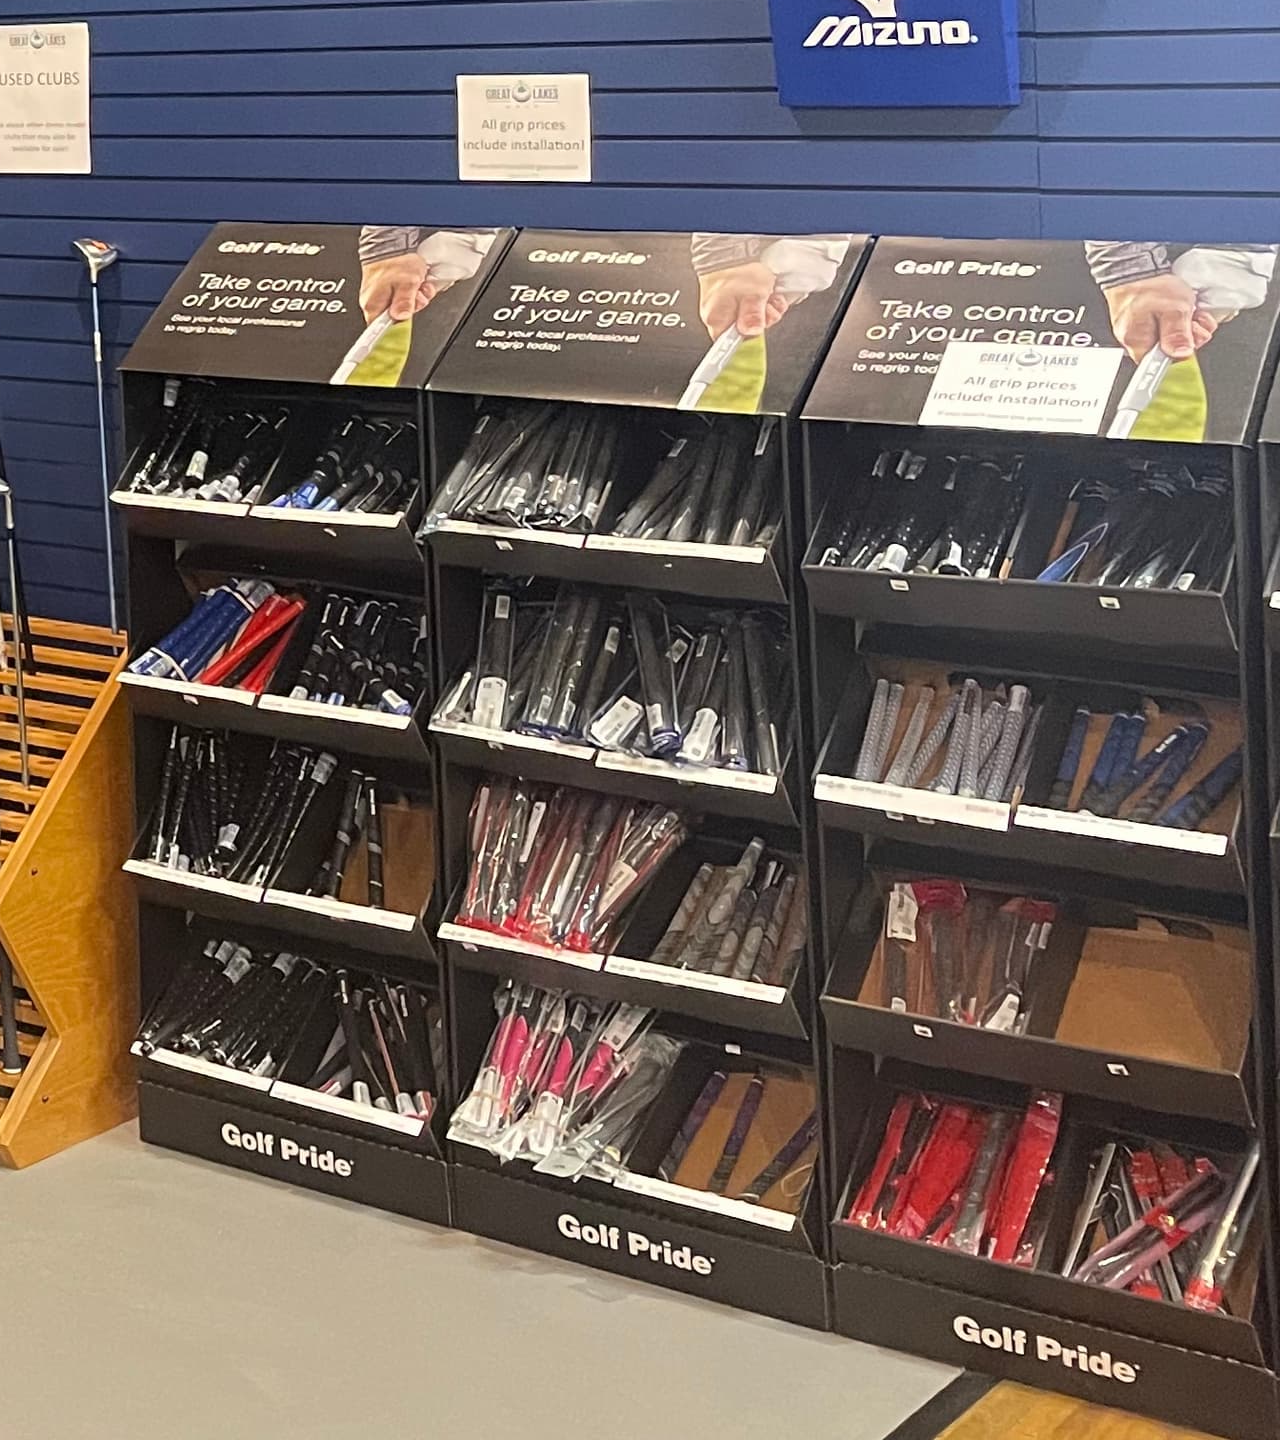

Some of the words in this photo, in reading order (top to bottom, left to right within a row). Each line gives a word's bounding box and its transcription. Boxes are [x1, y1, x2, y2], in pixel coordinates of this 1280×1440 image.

[803, 15, 979, 48] MIZUNO
[37, 71, 80, 86] CLUBS
[485, 88, 510, 100] GREAT
[533, 88, 558, 100] LAKES
[481, 119, 497, 130] All
[500, 121, 524, 132] grip
[528, 120, 566, 131] prices
[464, 140, 507, 151] include
[511, 139, 585, 152] installation!
[218, 241, 263, 254] Golf
[263, 242, 322, 256] Pride
[528, 249, 578, 263] Golf
[581, 251, 648, 265] Pride
[894, 259, 954, 277] Golf
[957, 261, 1036, 278] Pride
[198, 273, 251, 291] Take
[256, 277, 344, 294] control
[181, 293, 212, 308] of
[213, 297, 268, 312] your
[271, 297, 347, 314] game.
[509, 285, 570, 303] Take
[577, 287, 680, 306] control
[493, 305, 525, 323] of
[526, 309, 592, 326] your
[599, 309, 687, 329] game.
[878, 300, 954, 319] Take
[962, 304, 1086, 325] control
[865, 324, 902, 342] of
[904, 327, 985, 345] your
[993, 329, 1100, 347] game.
[857, 350, 883, 360] See
[885, 351, 919, 363] your
[852, 363, 866, 373] to
[964, 376, 986, 386] All
[989, 379, 1022, 389] grip
[1026, 381, 1077, 391] prices
[933, 391, 993, 403] include
[998, 394, 1100, 408] installation!
[221, 1123, 274, 1156] Golf
[281, 1138, 352, 1177] Pride
[558, 1214, 620, 1246] Golf
[628, 1232, 714, 1276] Pride
[953, 1316, 1026, 1355] Golf
[1036, 1336, 1137, 1384] Pride
